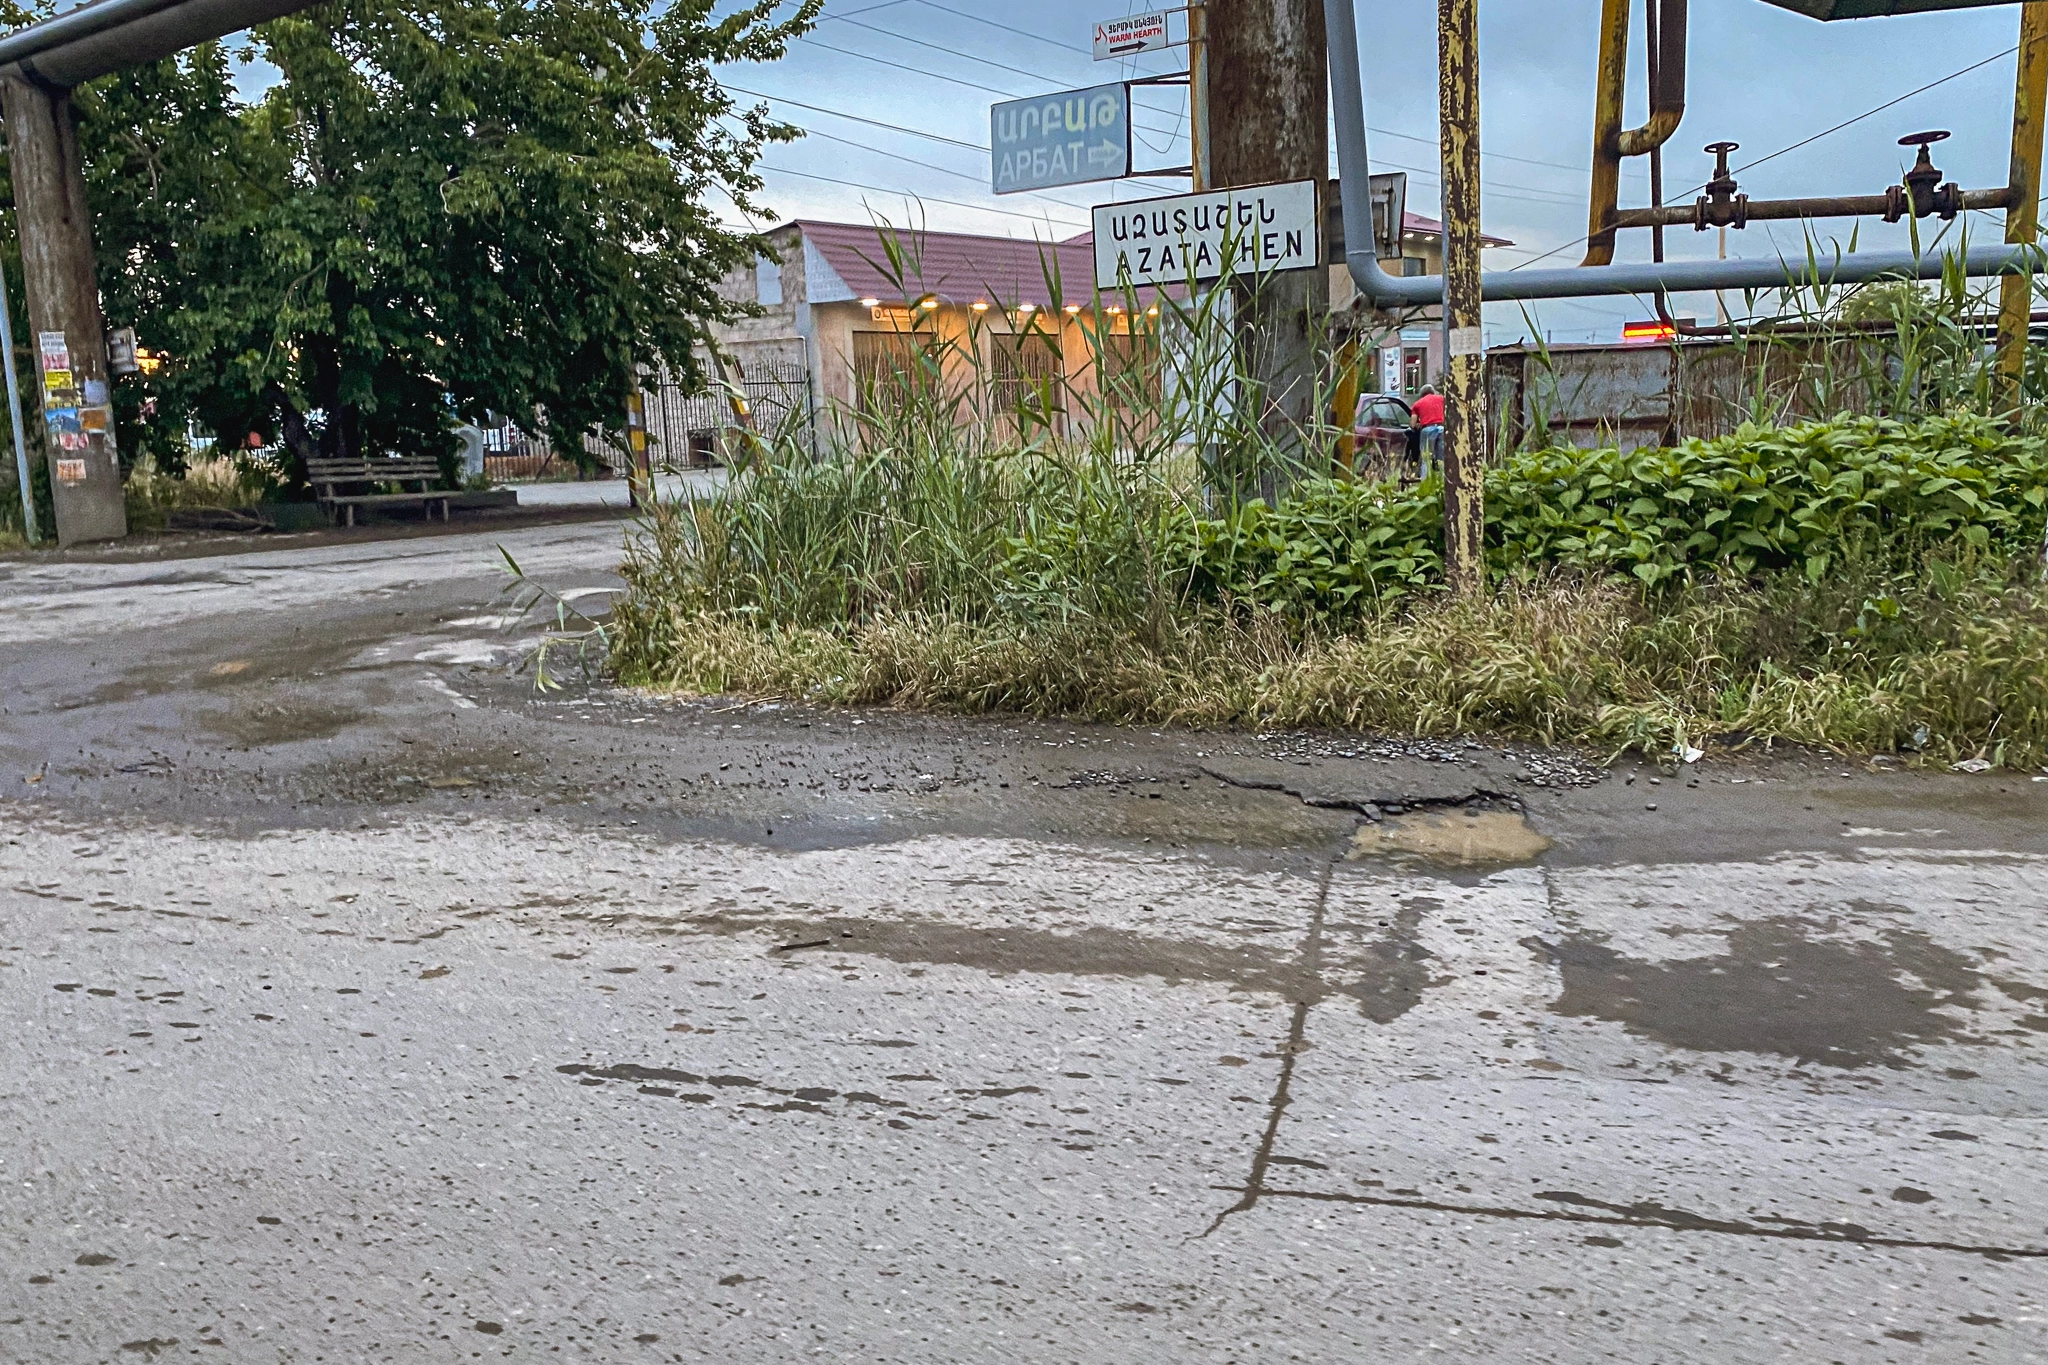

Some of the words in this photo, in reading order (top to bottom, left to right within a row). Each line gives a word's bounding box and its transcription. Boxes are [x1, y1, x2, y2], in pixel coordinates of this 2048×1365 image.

[1108, 33, 1132, 44] WARM
[1133, 27, 1163, 40] HEARTH
[997, 141, 1085, 184] АРБАТ
[1112, 197, 1276, 241] ԱԶԱՏԱՇԵՆ
[1115, 229, 1303, 277] AZATAHEN
